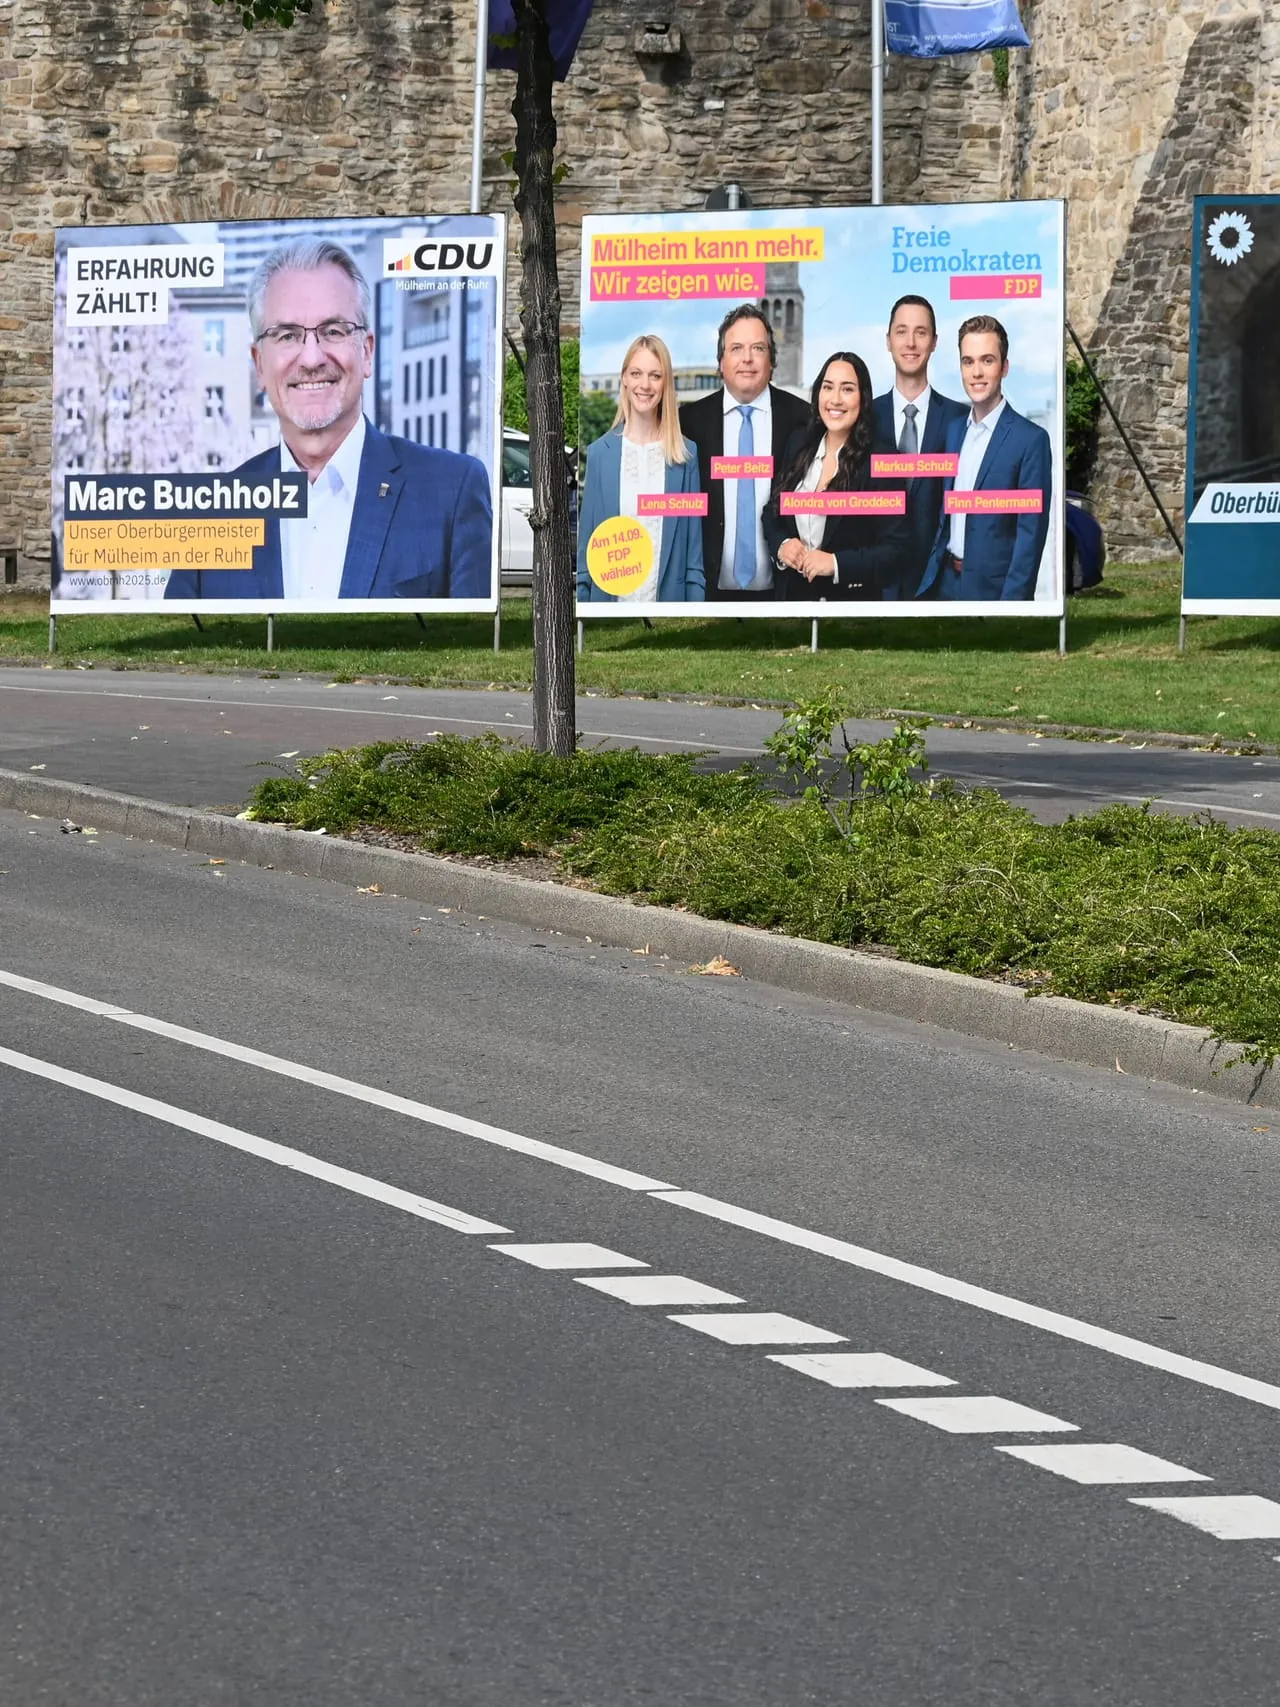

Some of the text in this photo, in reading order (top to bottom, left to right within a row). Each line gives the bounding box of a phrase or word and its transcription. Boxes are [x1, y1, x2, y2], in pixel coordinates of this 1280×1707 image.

[892, 225, 951, 248] Freie
[413, 243, 494, 271] CDU
[593, 233, 819, 262] Mülheim kann mehr.
[77, 256, 215, 281] ERFAHRUNG
[892, 248, 1042, 273] Demokraten
[395, 278, 489, 291] Mülheim an der Ruhr
[591, 267, 760, 299] Wir zeigen wie.
[1003, 278, 1039, 295] FDP
[76, 287, 157, 314] ZÄHLT!
[713, 461, 771, 474] Peter Beitz
[873, 459, 954, 473] Markus Schulz
[69, 478, 299, 511] Marc Buchholz
[640, 498, 704, 510] Lena Schulz
[782, 496, 903, 509] Alondra von Groddeck
[947, 496, 1041, 508] Finn Pentermann
[69, 522, 260, 542] Unser Oberbürgermeister
[591, 528, 643, 550] Am 14.09.
[69, 546, 250, 564] für Mülheim an der Ruhr
[607, 547, 631, 563] FDP
[69, 574, 167, 586] www.obmh2025.de
[601, 561, 643, 582] wählen!
